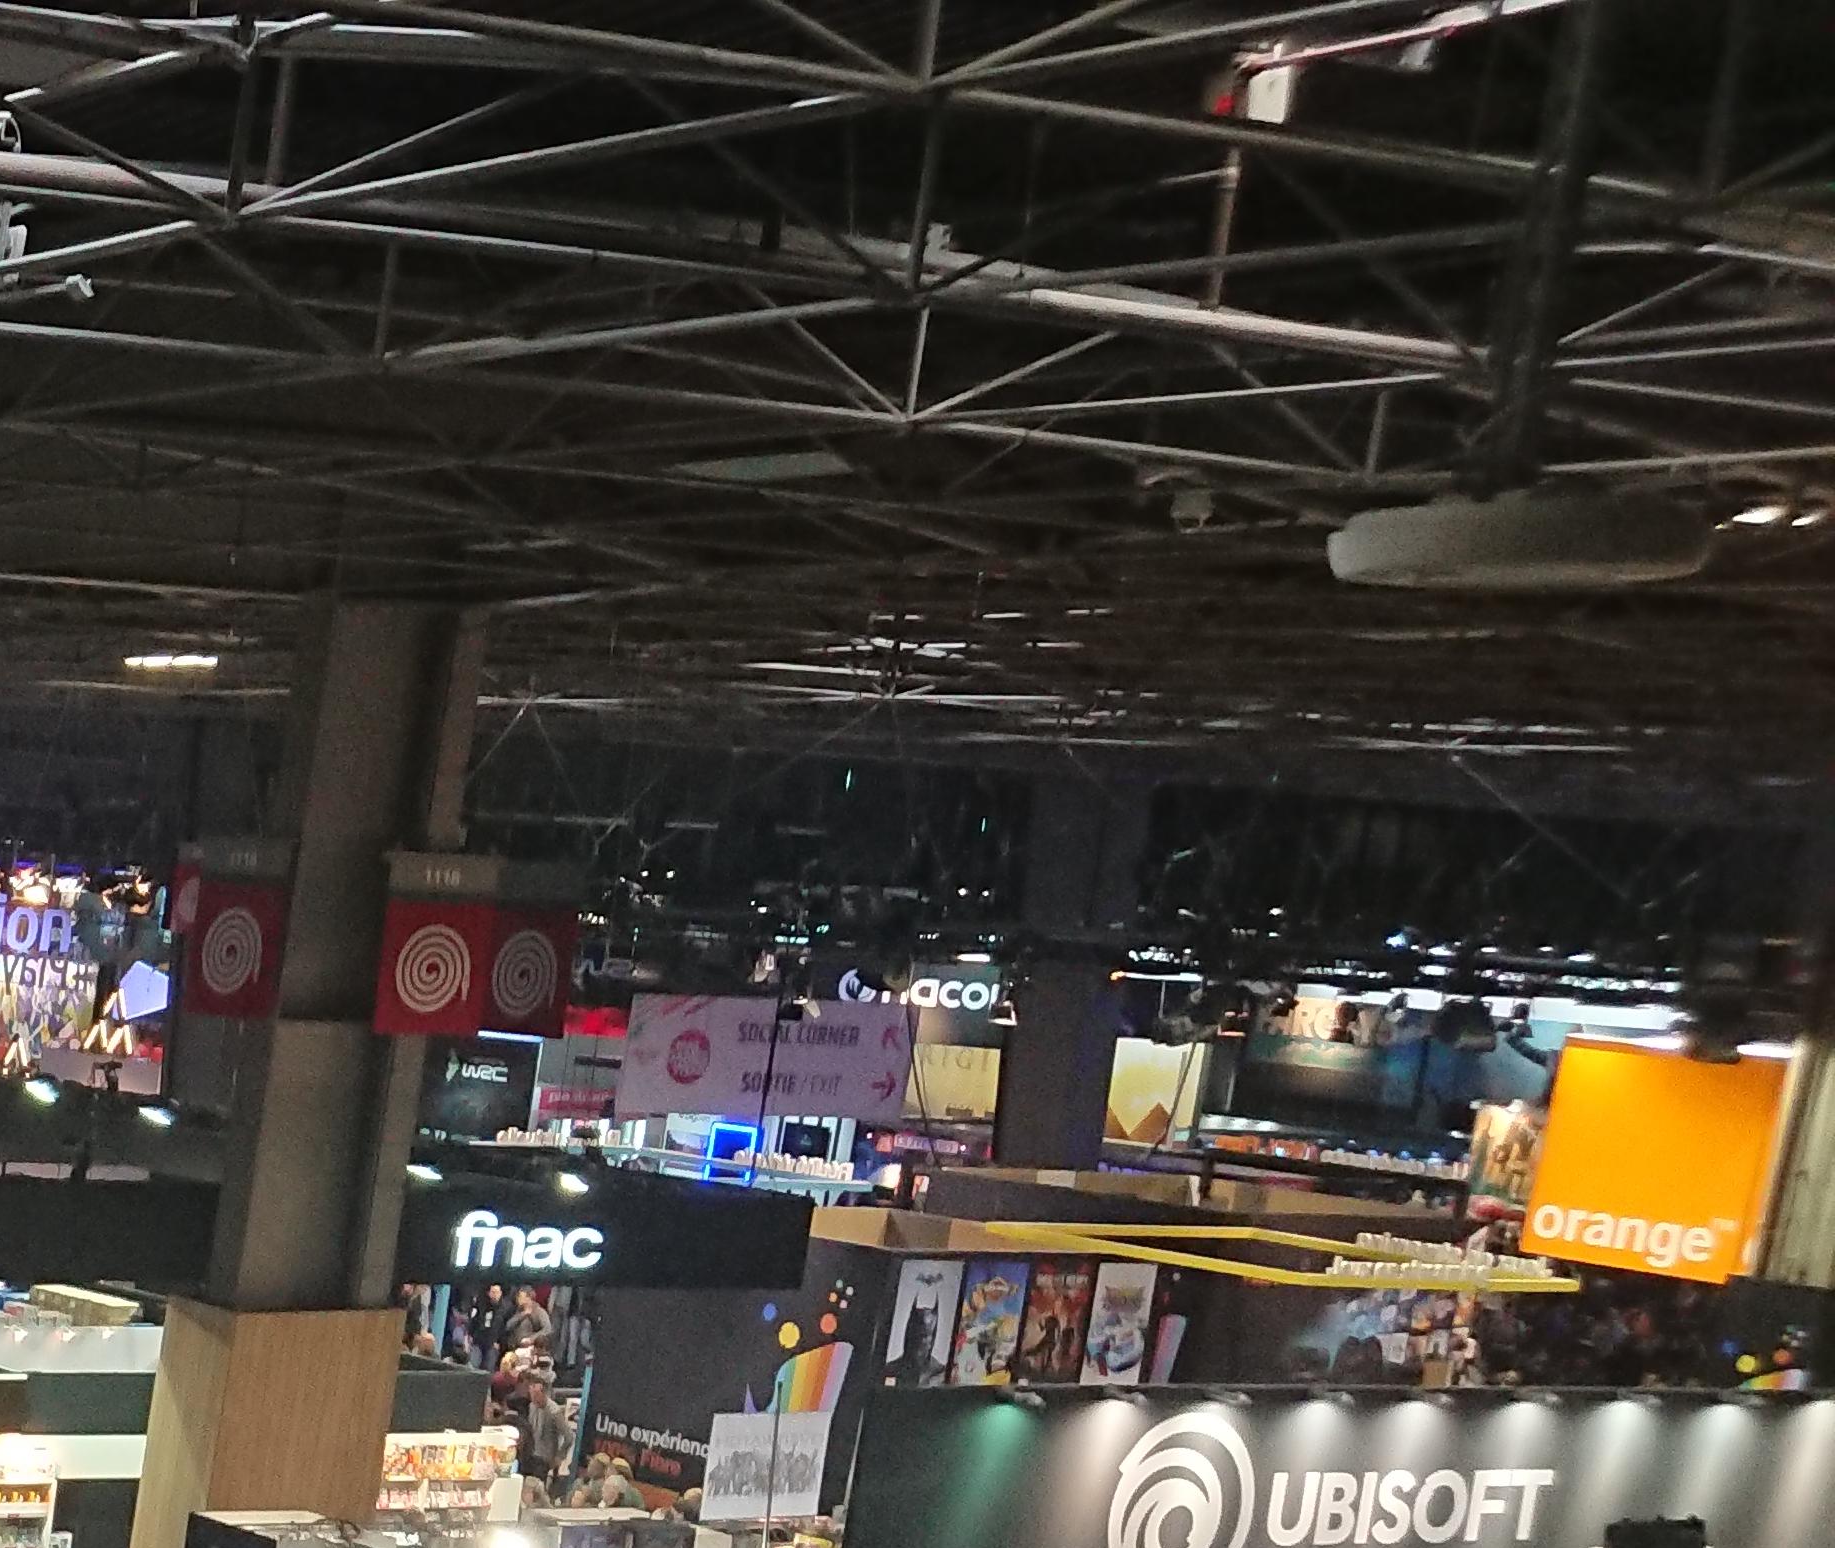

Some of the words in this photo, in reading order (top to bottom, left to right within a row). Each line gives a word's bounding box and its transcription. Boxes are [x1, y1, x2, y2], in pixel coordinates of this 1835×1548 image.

[455, 1210, 603, 1268] fnac
[1533, 1203, 1712, 1269] orange
[1267, 1468, 1554, 1547] UBISOFT
